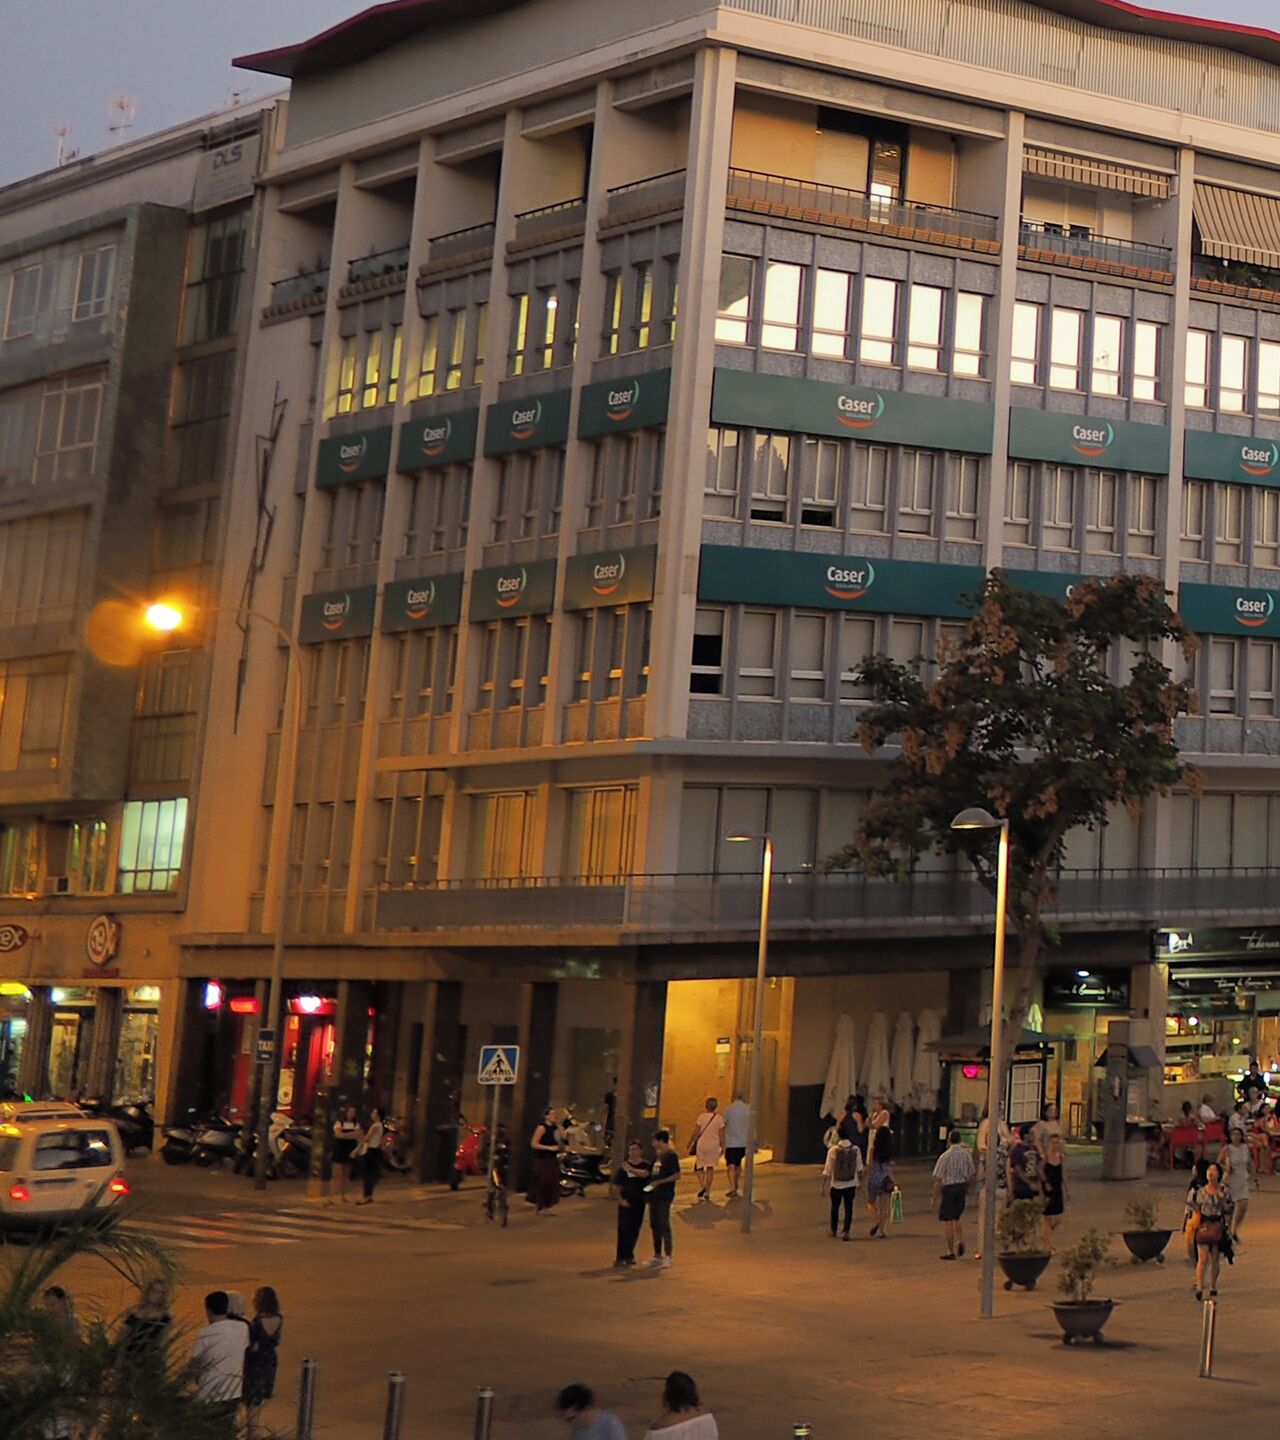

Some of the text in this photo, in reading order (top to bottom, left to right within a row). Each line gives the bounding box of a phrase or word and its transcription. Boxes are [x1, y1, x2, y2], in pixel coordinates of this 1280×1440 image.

[608, 390, 634, 406] Caser
[837, 395, 875, 413] Caser
[512, 409, 536, 425] Caser
[423, 427, 446, 442] Caser
[1072, 425, 1106, 442] Caser
[340, 444, 362, 458] Caser
[1241, 446, 1271, 462] Caser
[593, 564, 619, 580] Caser
[827, 566, 865, 583] Caser
[497, 577, 524, 592] Caser
[407, 589, 431, 604] Caser
[1236, 597, 1267, 612] Caser
[324, 601, 345, 616] Caser
